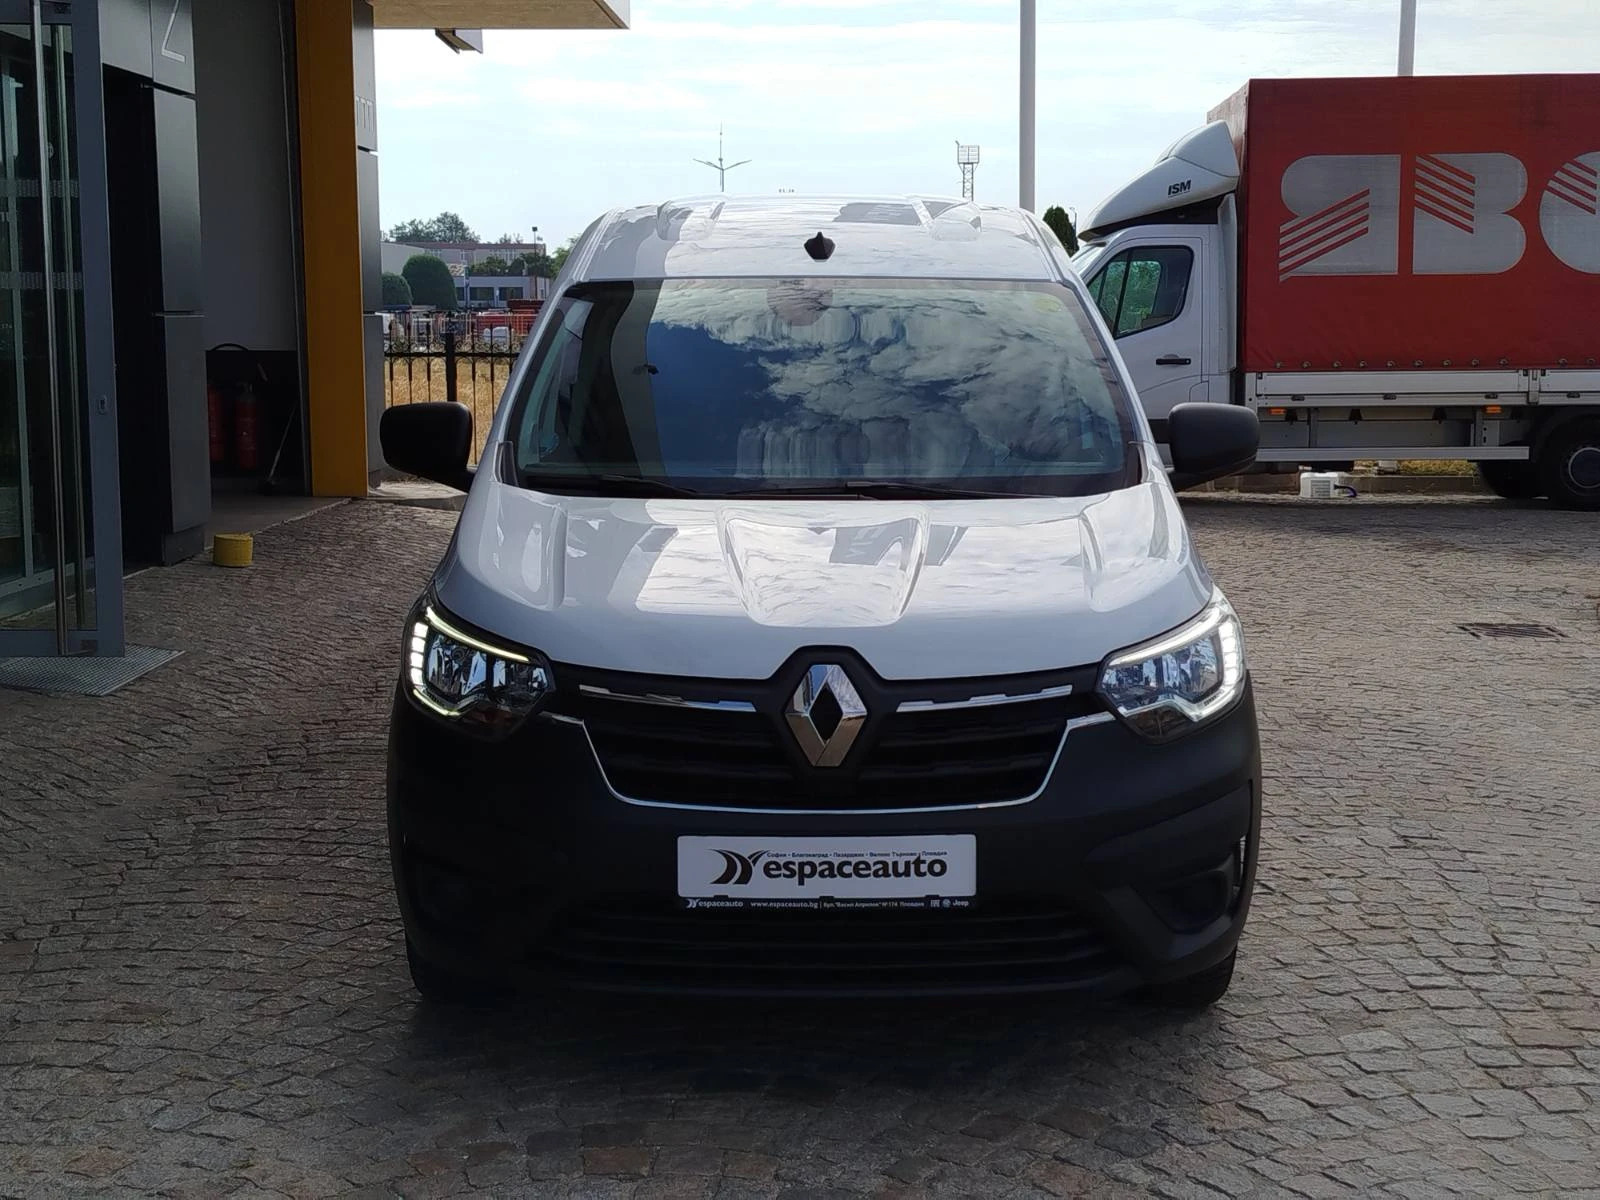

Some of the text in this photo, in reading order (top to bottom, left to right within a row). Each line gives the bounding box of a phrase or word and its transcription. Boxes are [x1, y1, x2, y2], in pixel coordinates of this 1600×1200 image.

[1168, 179, 1192, 196] ISM
[763, 853, 948, 886] espaceauto
[698, 900, 744, 908] espaceauto
[750, 901, 818, 909] www.espaceauto.bg
[952, 899, 969, 907] Jeep
